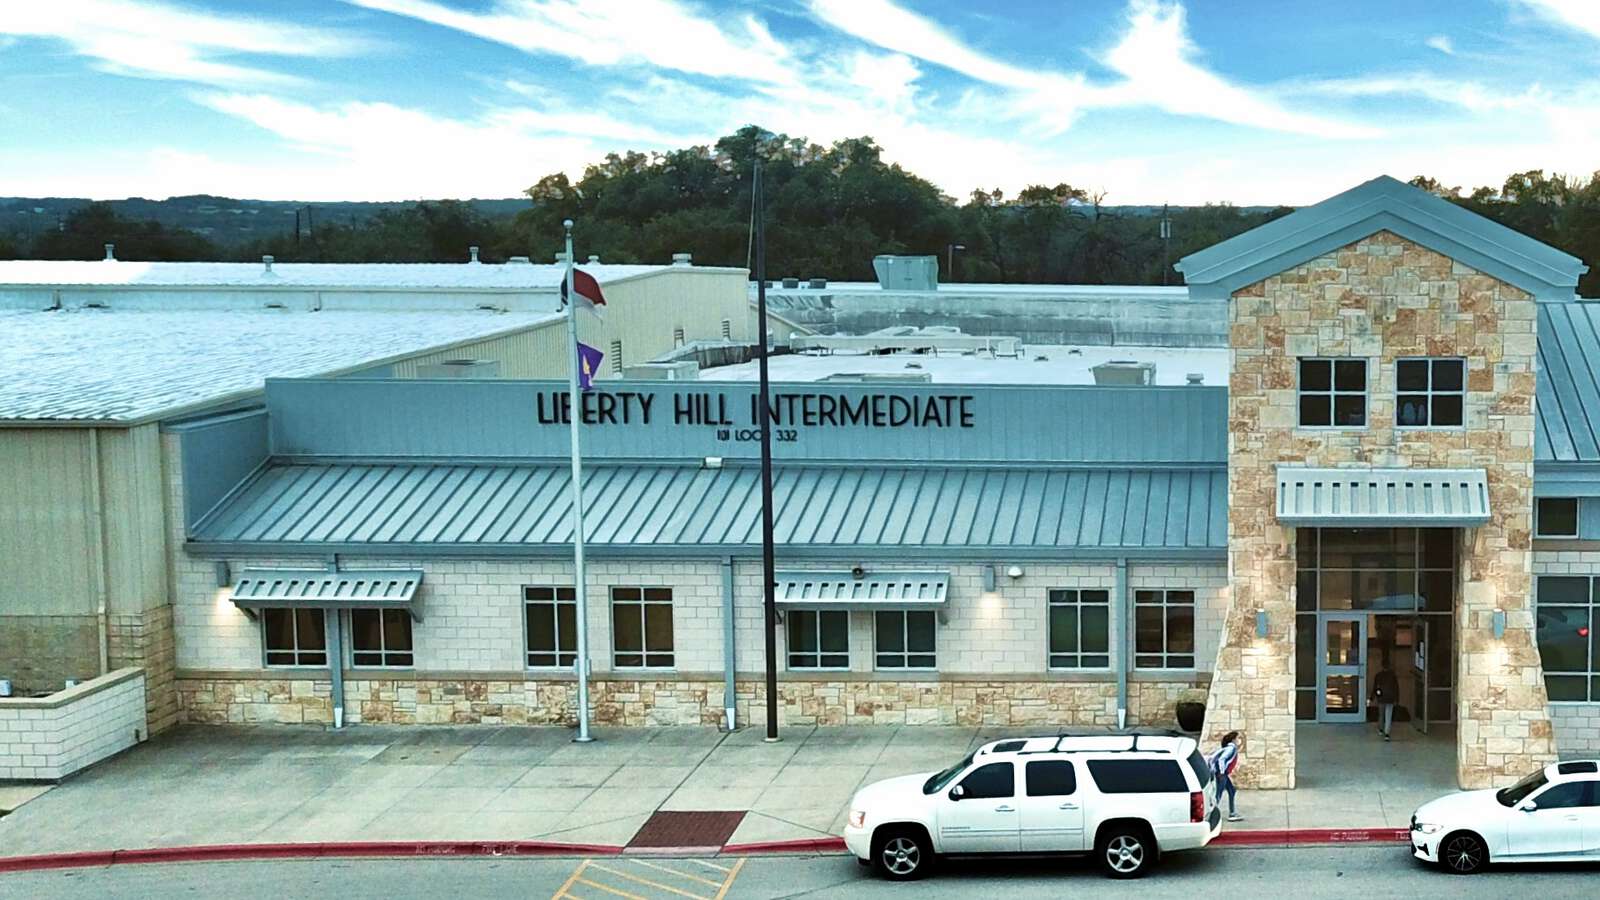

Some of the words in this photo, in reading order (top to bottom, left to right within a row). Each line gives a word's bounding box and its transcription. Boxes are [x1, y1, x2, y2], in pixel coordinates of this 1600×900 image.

[537, 392, 655, 424] LIBERTY
[674, 393, 733, 425] HILL
[751, 393, 974, 427] INTERMEDIATE
[735, 429, 765, 441] LOO
[776, 429, 798, 442] 332
